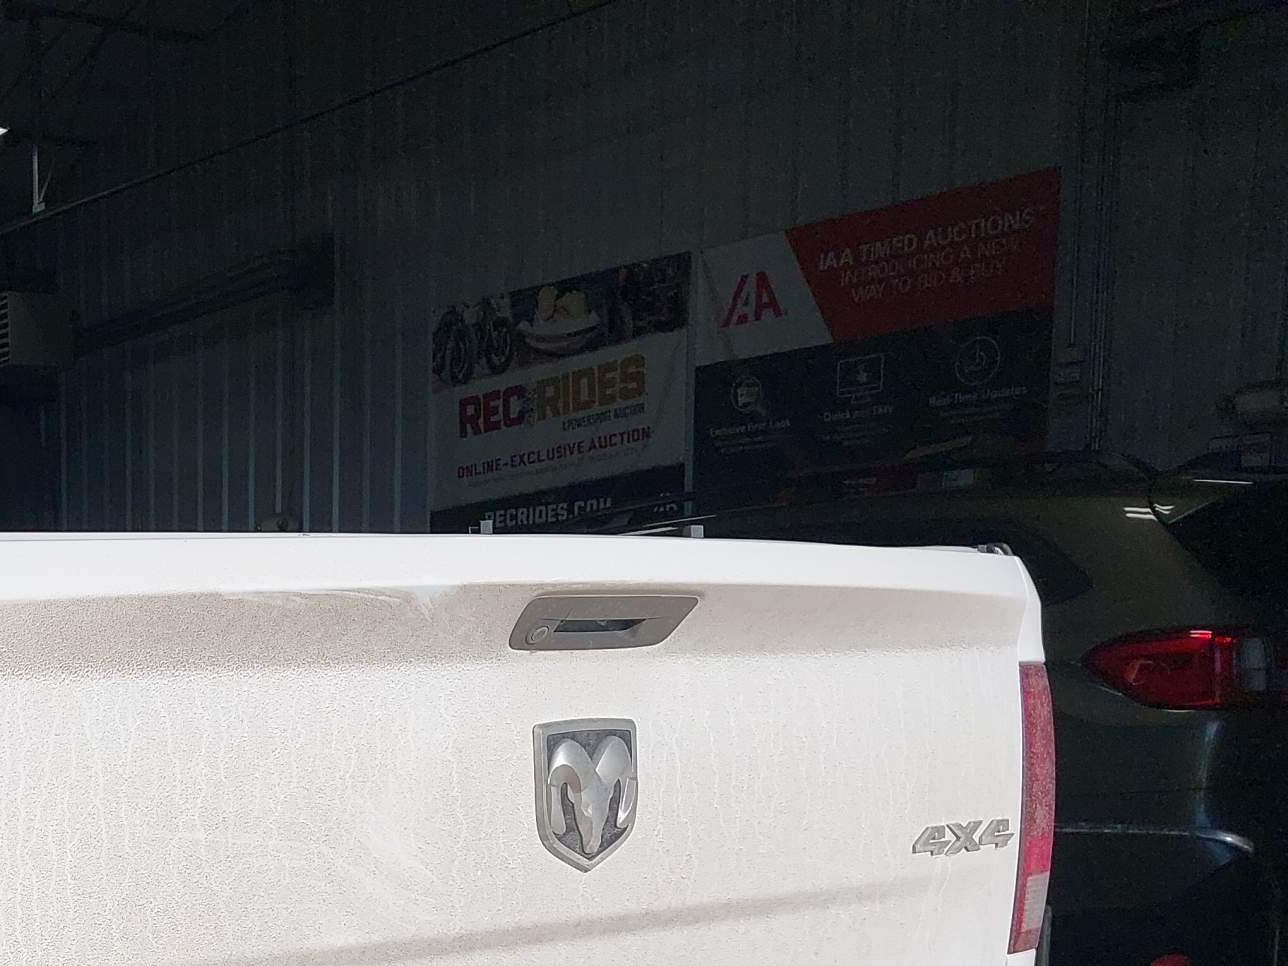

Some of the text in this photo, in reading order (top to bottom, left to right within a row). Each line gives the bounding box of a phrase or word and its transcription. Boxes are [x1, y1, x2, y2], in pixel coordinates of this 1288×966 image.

[859, 233, 919, 263] TIMED
[924, 207, 1034, 248] AUCTIONS
[851, 282, 886, 303] WAY
[457, 440, 584, 479] ONLINE-EXCLUSIVE
[589, 426, 653, 452] AUCTION
